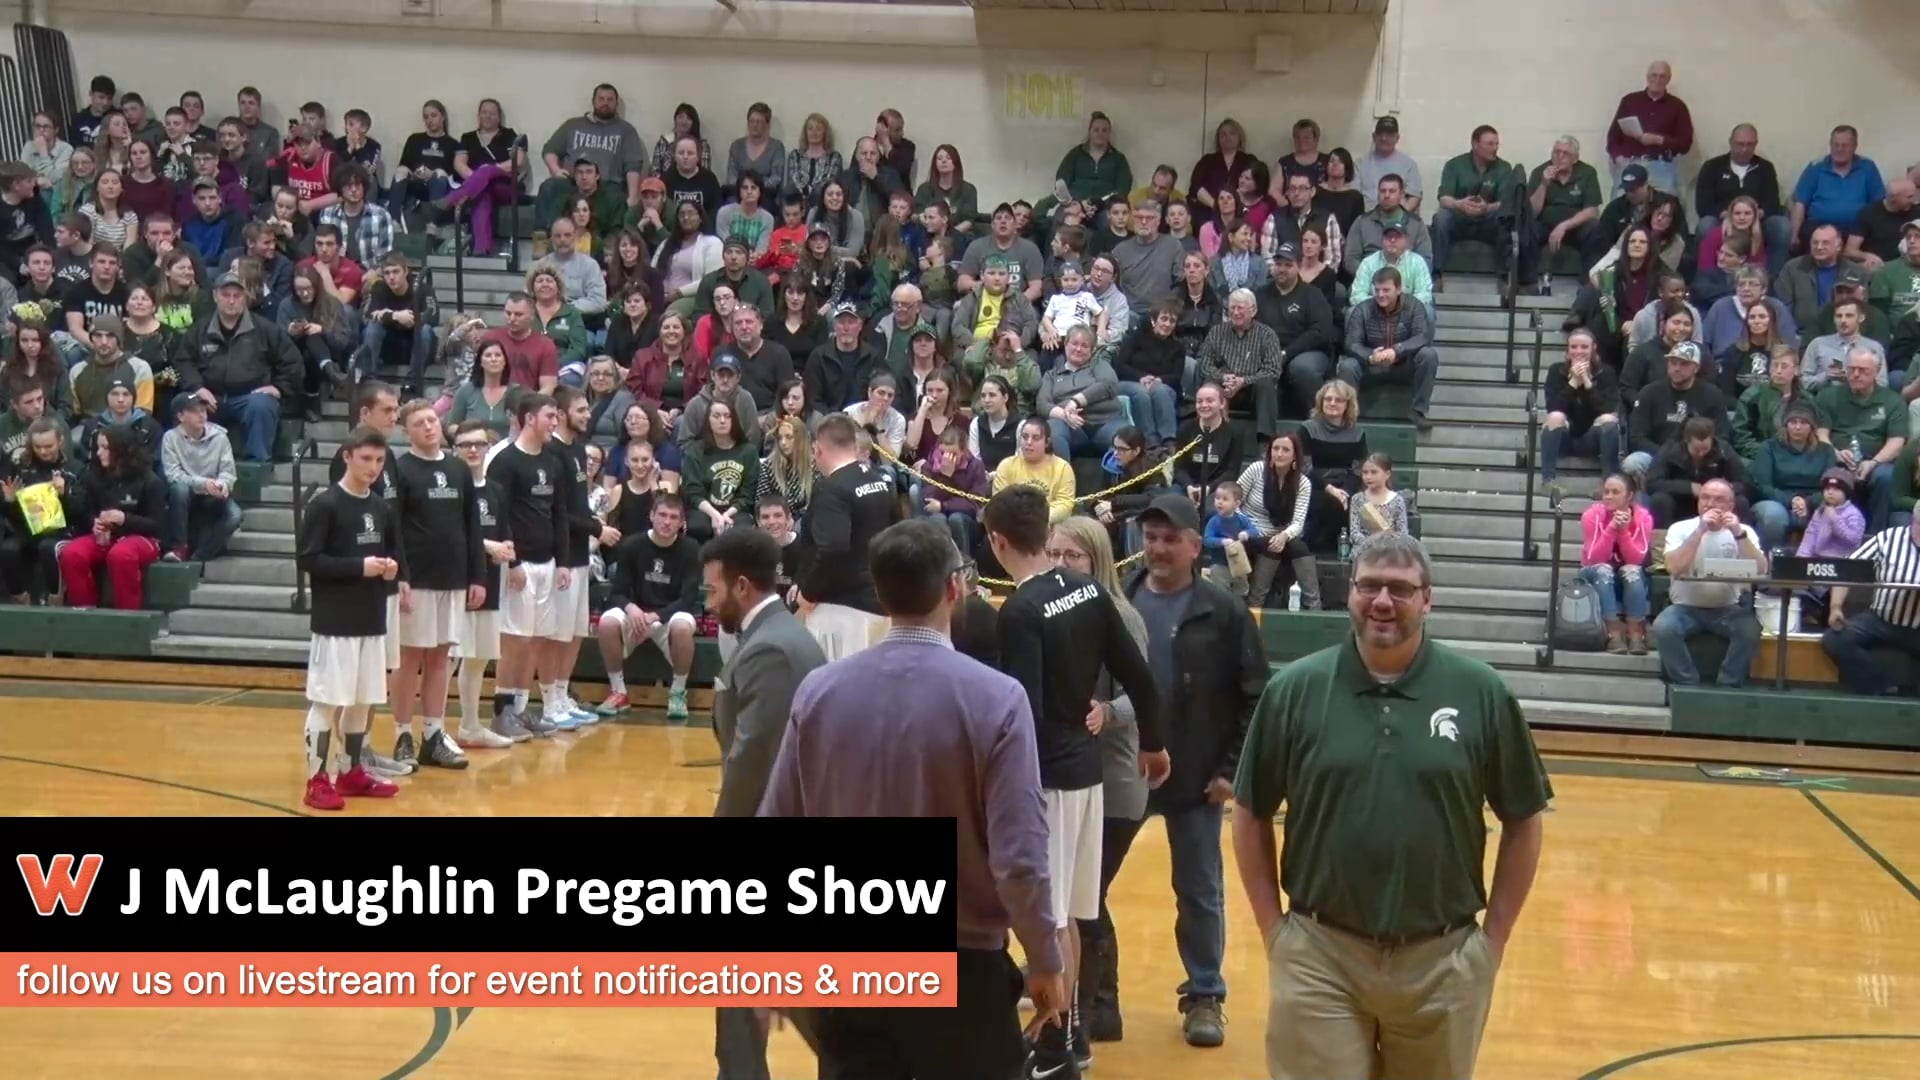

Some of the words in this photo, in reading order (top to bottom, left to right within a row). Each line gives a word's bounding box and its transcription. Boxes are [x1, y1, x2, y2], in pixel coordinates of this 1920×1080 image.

[1005, 72, 1083, 117] HOME
[573, 131, 622, 154] EVERLAST
[288, 177, 323, 191] ROCKETS
[855, 481, 889, 498] OUELLETTE
[1807, 563, 1838, 578] POSS.
[1043, 584, 1099, 619] JANDREAU
